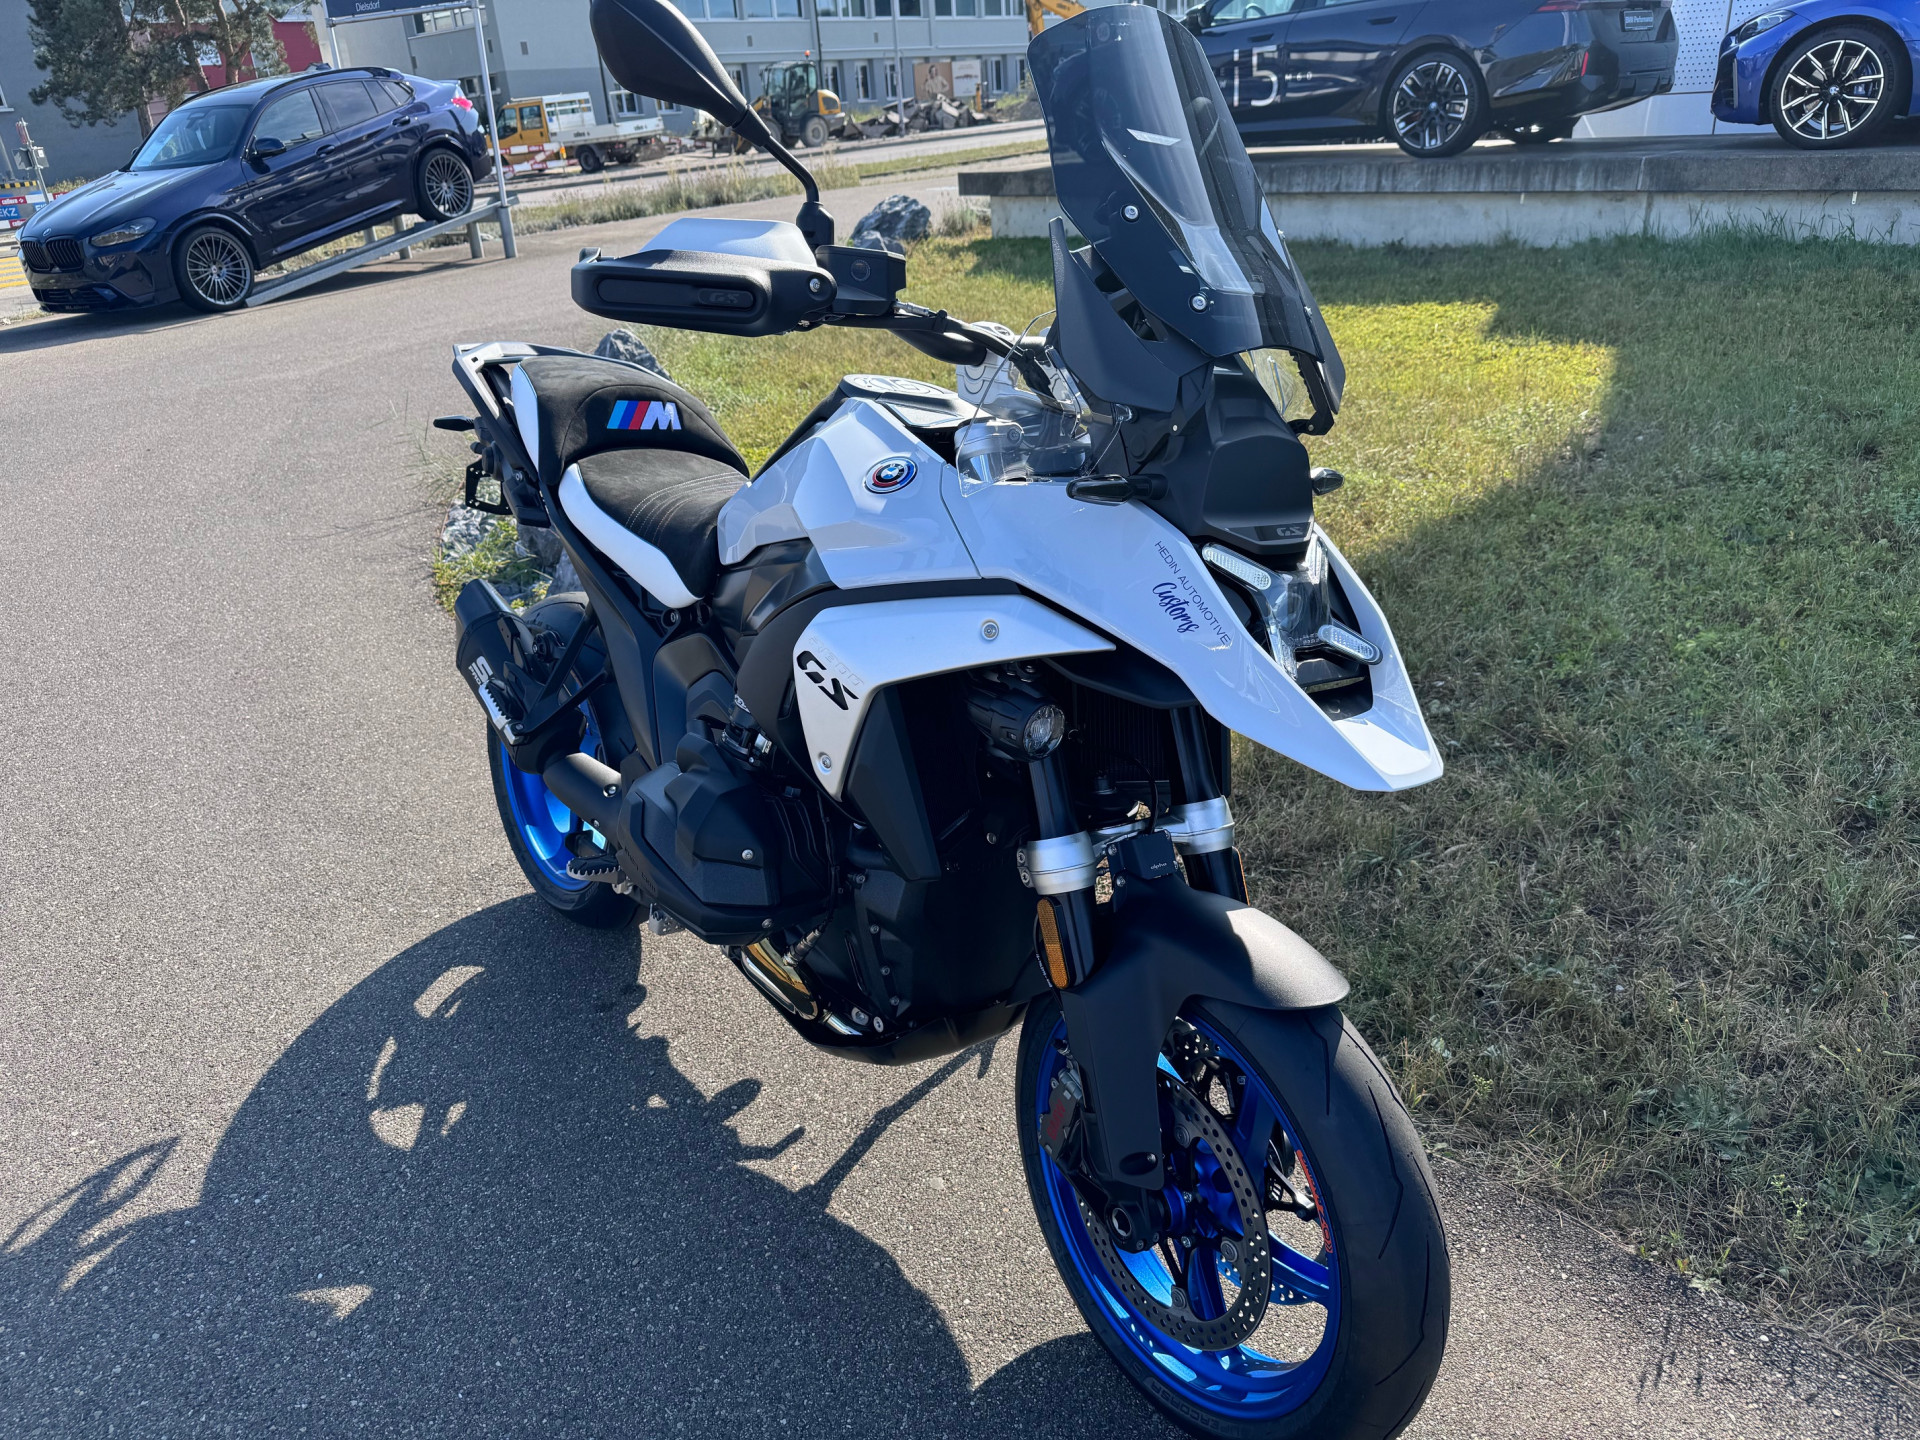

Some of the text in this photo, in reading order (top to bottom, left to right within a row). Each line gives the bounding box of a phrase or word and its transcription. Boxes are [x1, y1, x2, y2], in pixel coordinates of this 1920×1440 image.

[355, 0, 381, 12] Dielsdorf
[1233, 44, 1279, 107] i5
[1152, 582, 1200, 634] Customs
[1154, 540, 1231, 645] HEDIN AUTOMOTIVE
